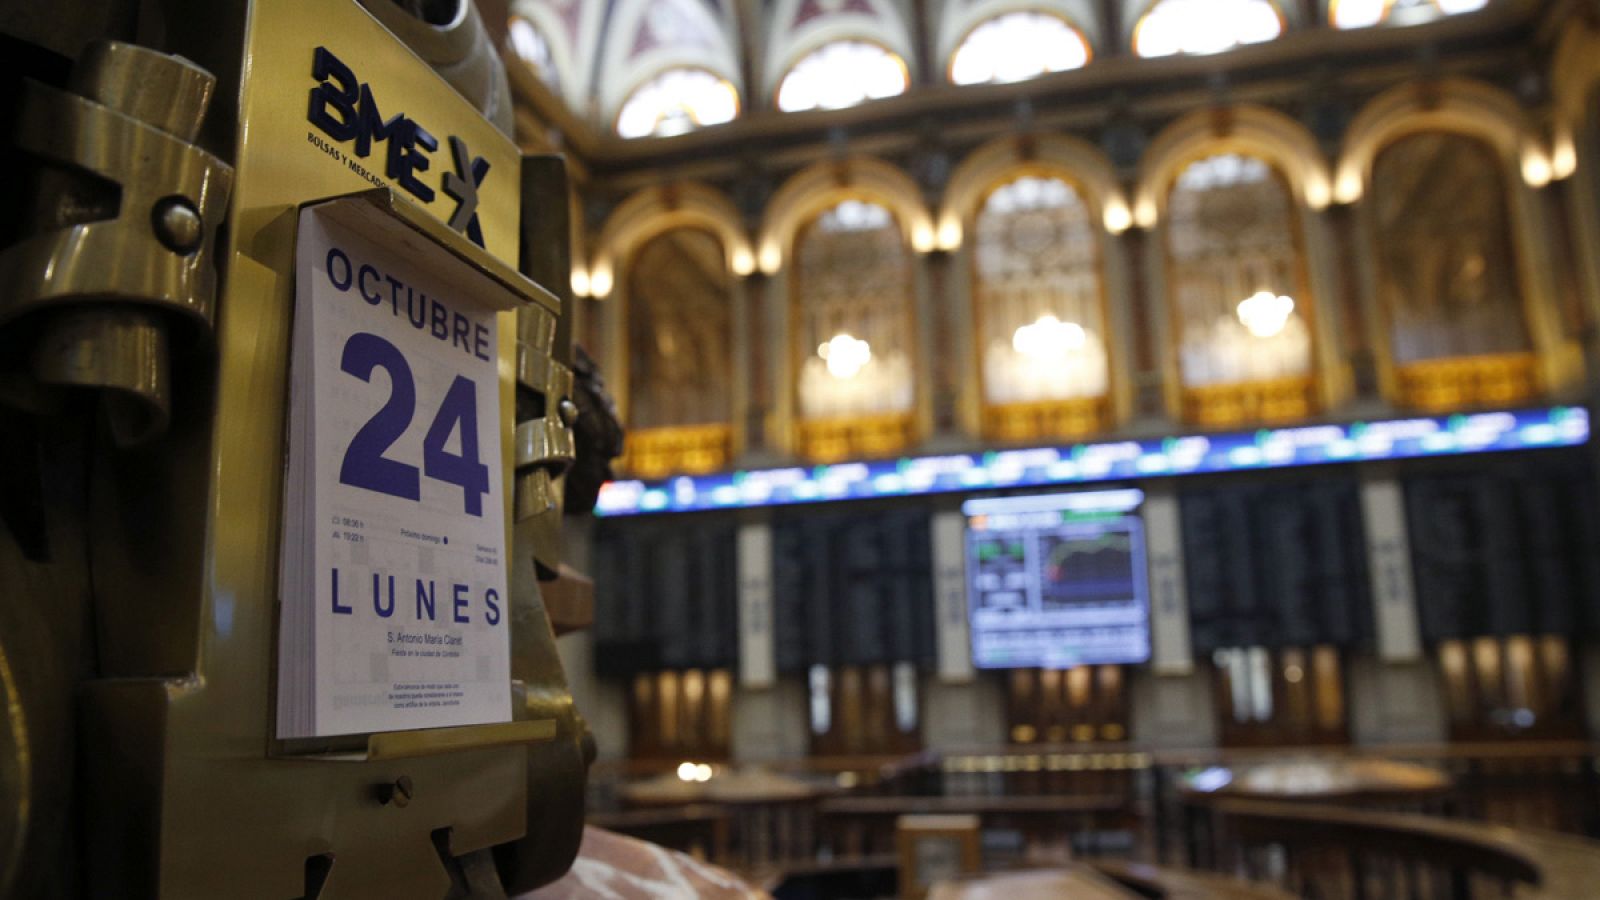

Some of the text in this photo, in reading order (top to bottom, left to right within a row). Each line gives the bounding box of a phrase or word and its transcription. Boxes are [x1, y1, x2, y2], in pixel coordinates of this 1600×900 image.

[307, 132, 339, 160] BOLSAS
[341, 154, 347, 165] Y
[326, 248, 490, 362] OCTUBRE
[339, 332, 490, 517] 24
[331, 568, 500, 626] LUNES
[387, 632, 395, 643] S.
[397, 632, 423, 645] Antonio
